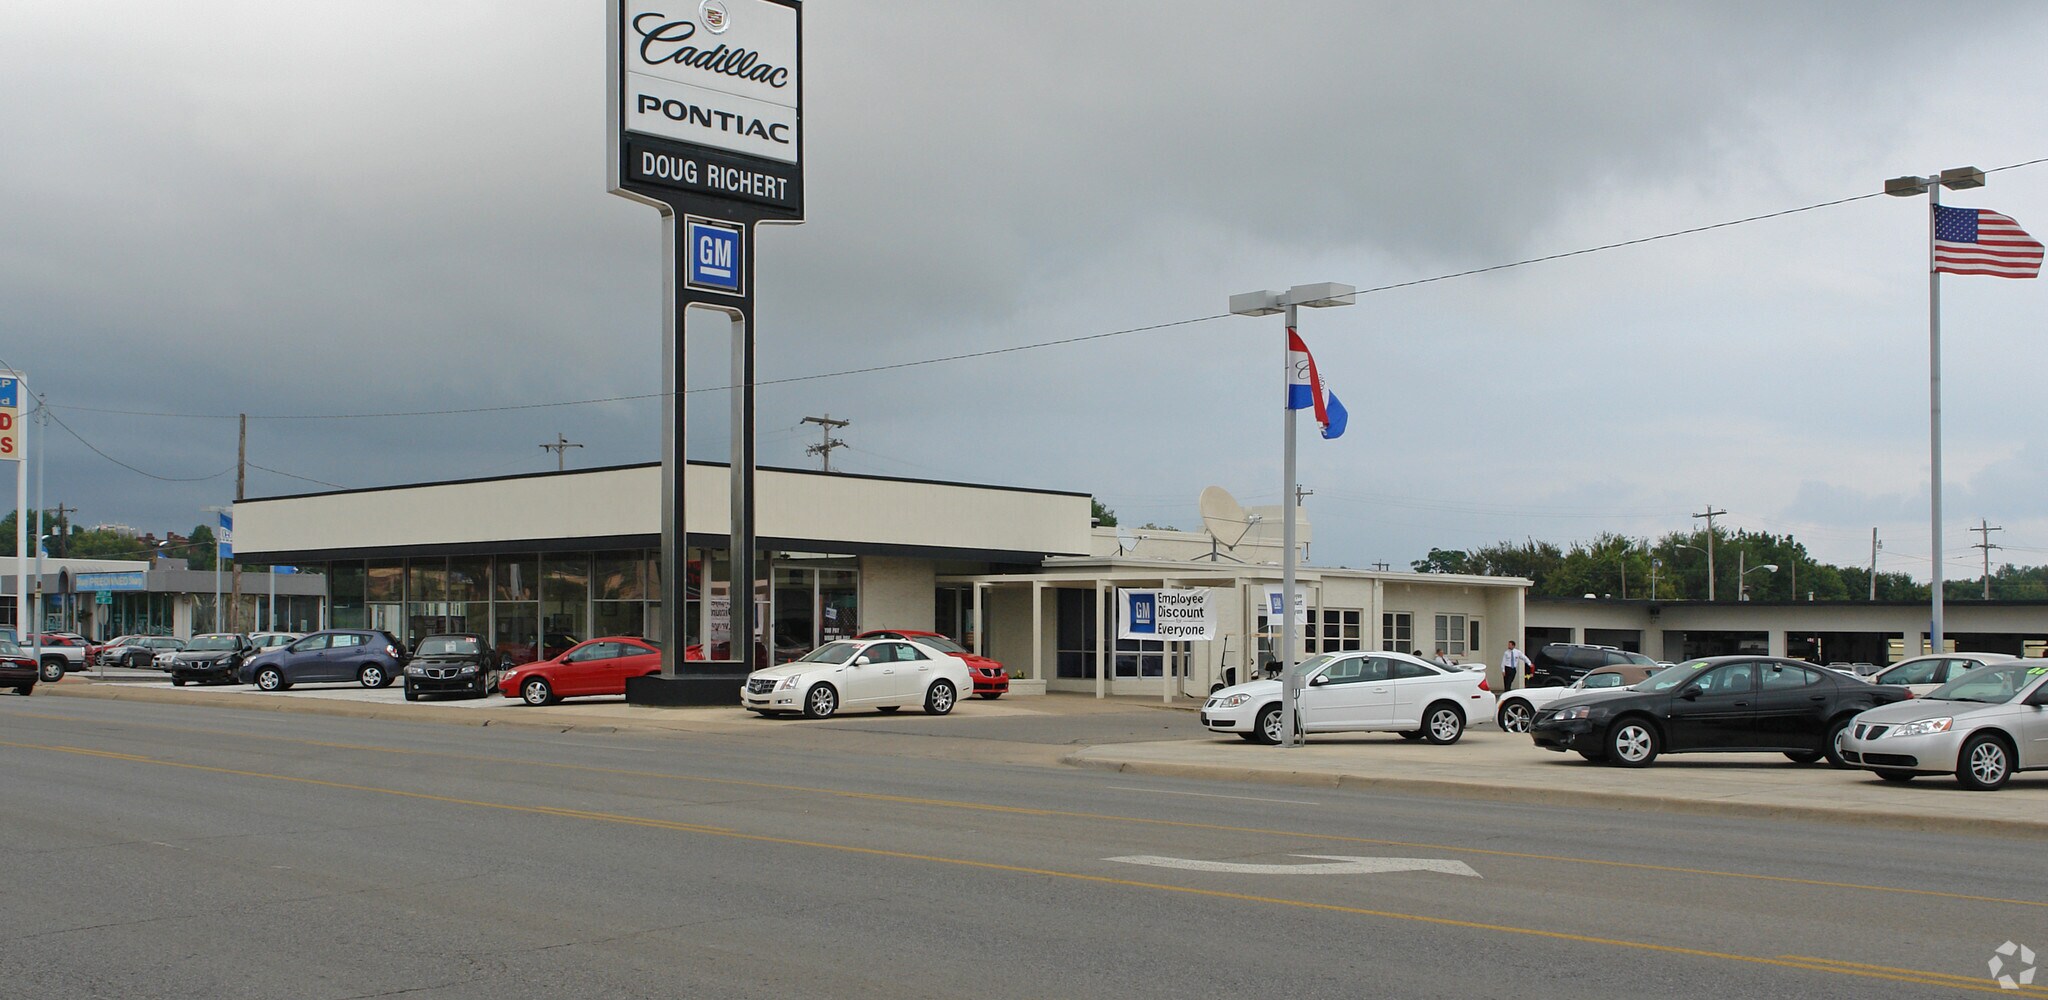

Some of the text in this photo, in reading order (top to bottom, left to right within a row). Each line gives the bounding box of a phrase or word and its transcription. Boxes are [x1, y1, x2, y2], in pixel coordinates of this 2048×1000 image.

[632, 12, 788, 88] Cadillac
[638, 94, 789, 144] PONTIAC
[642, 151, 788, 200] DOUG RICHERT
[700, 235, 732, 268] GM
[1135, 601, 1150, 619] GM
[1158, 592, 1204, 606] Employee
[1158, 605, 1205, 618] Discount
[1158, 623, 1205, 637] Everyone
